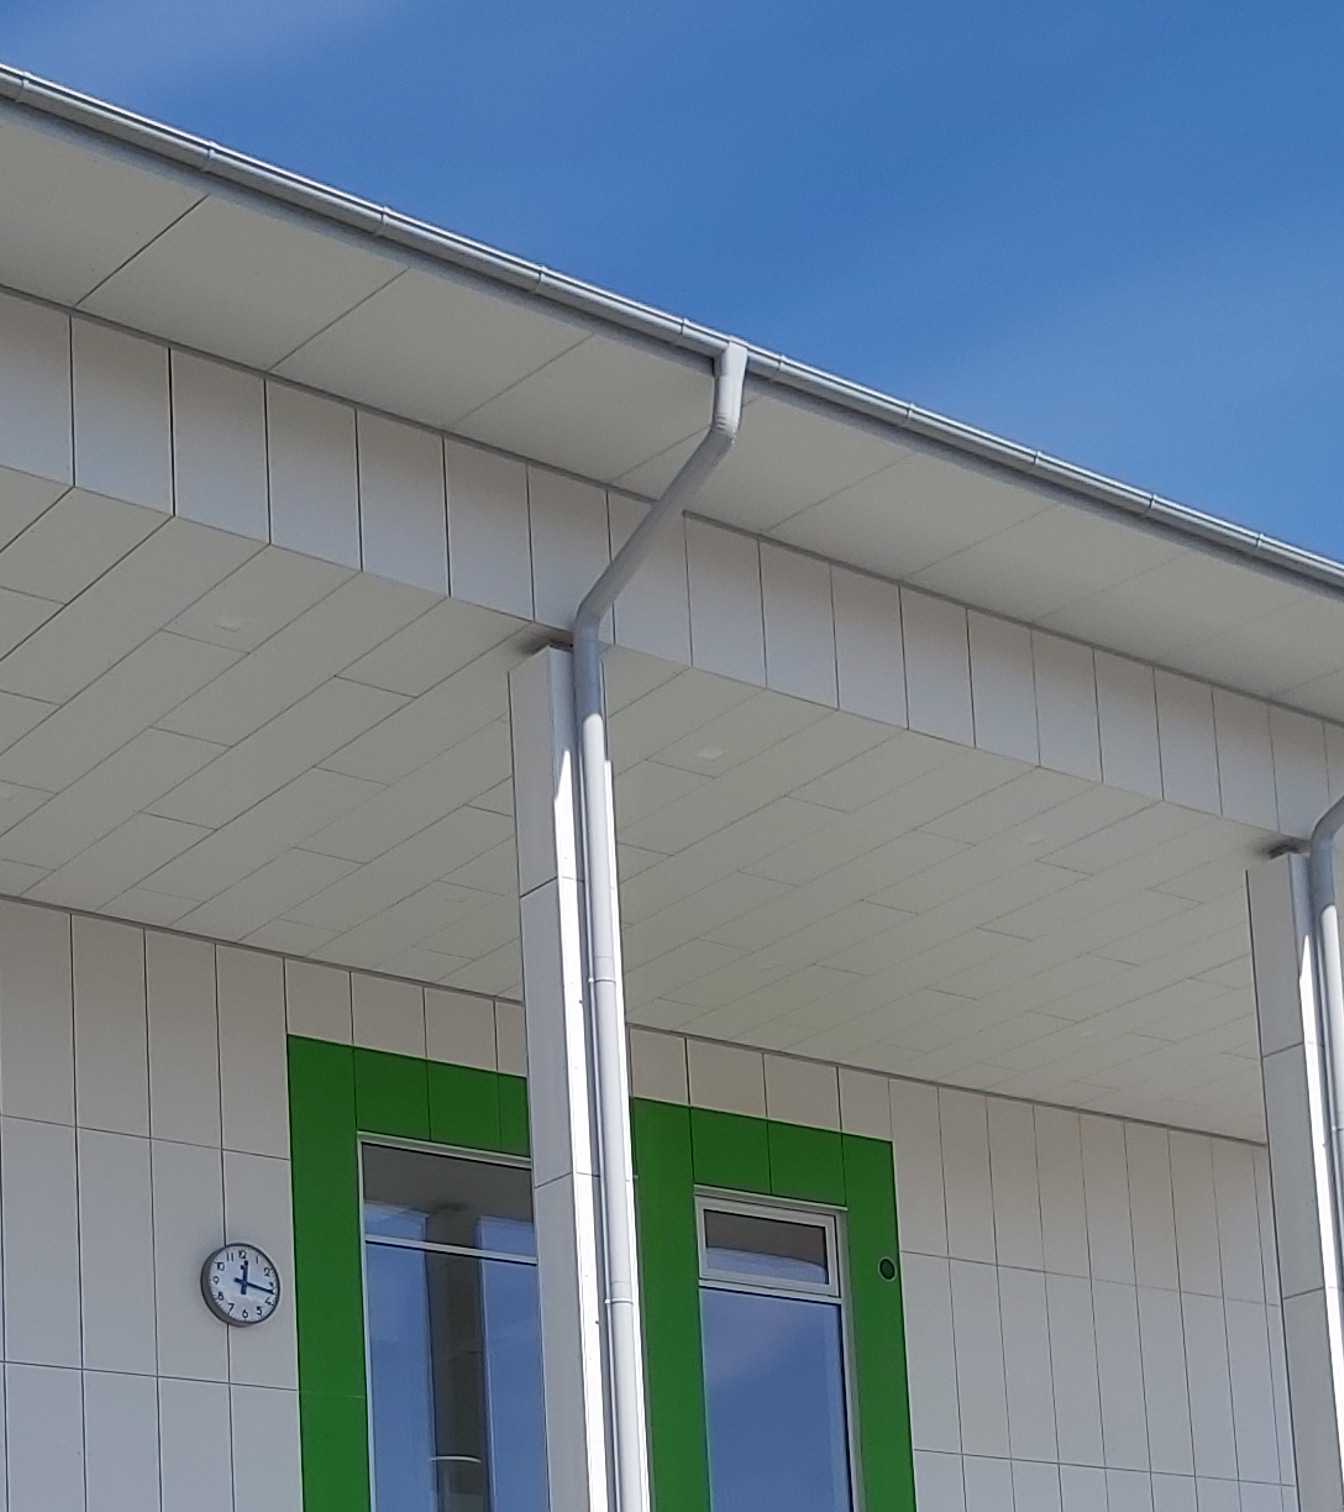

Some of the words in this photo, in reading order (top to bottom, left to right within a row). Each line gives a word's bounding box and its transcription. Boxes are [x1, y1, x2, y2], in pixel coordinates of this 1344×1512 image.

[227, 1302, 235, 1312] 7
[256, 1306, 263, 1316] 5
[242, 1309, 249, 1318] 6
